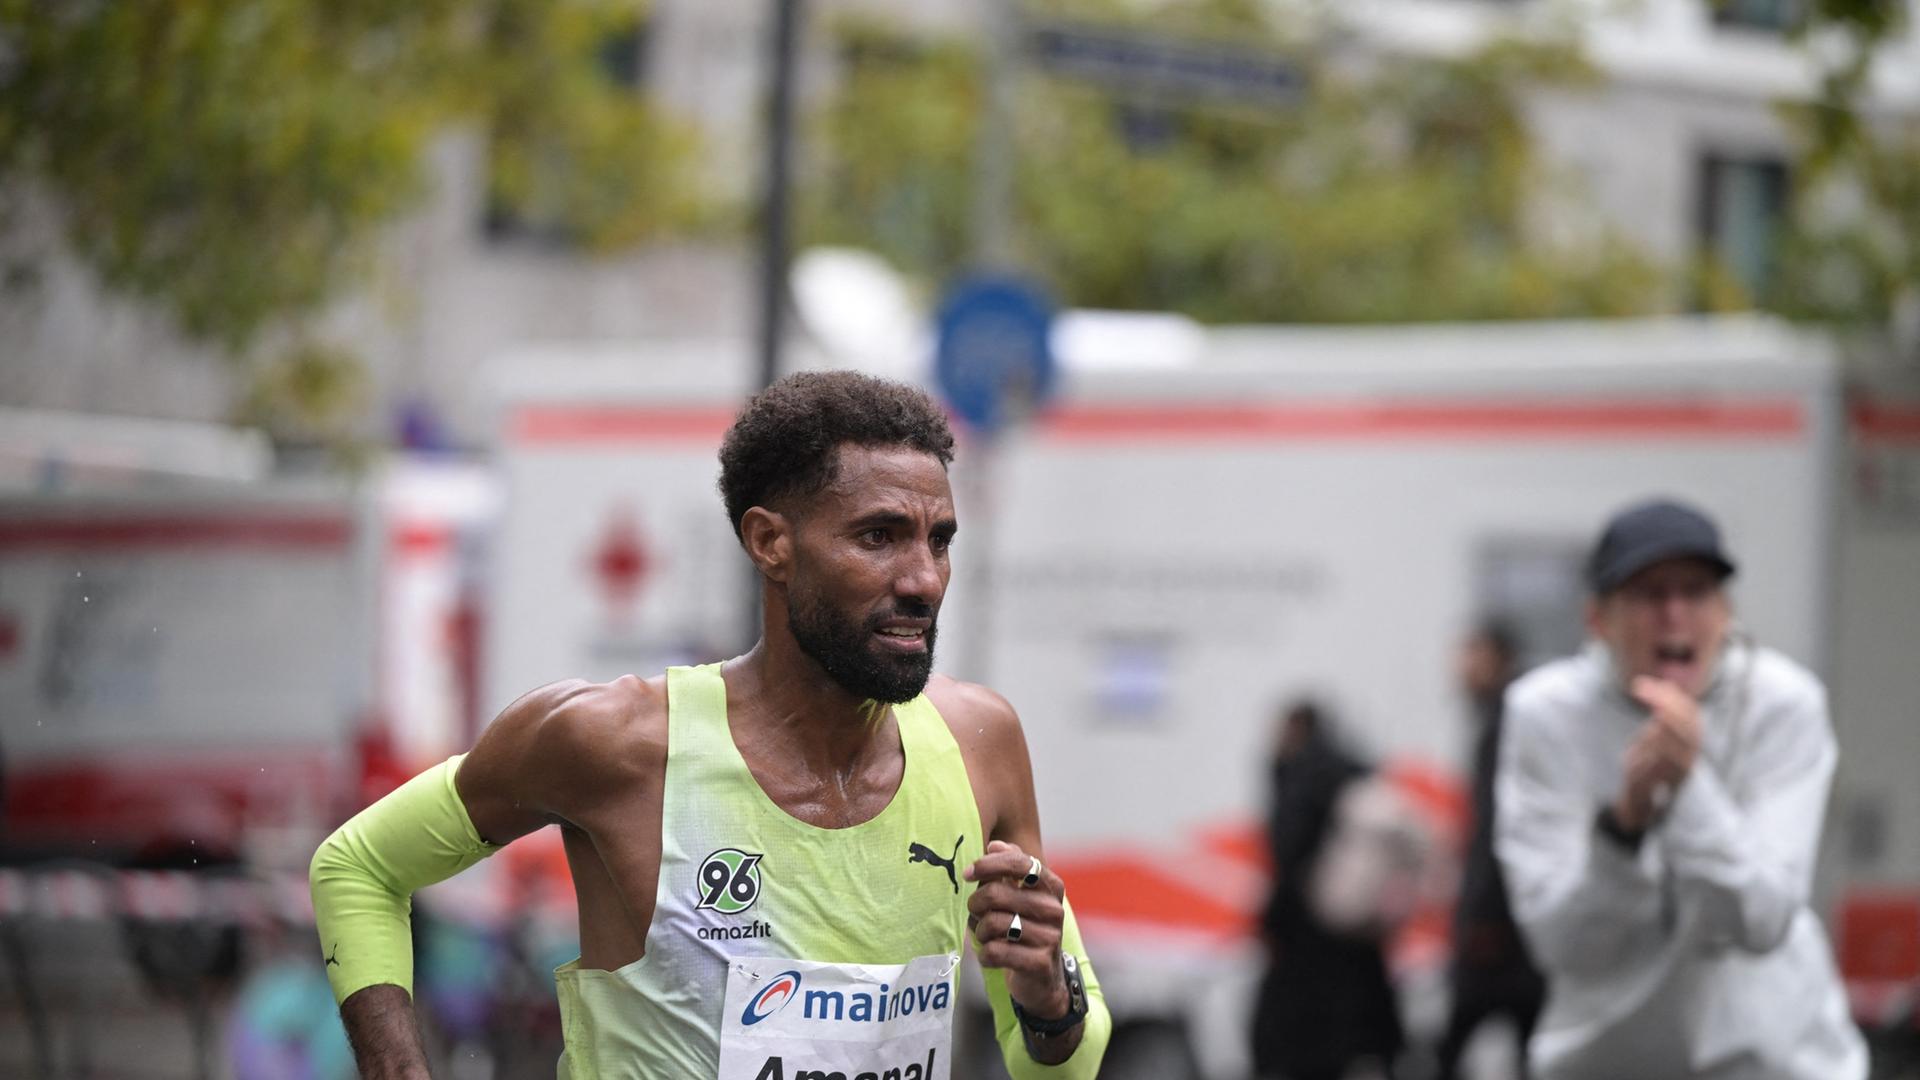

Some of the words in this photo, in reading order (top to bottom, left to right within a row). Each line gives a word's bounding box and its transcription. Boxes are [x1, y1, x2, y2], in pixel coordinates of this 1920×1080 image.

[701, 857, 758, 906] 96
[697, 920, 771, 941] amazfit
[803, 982, 950, 1023] mainova
